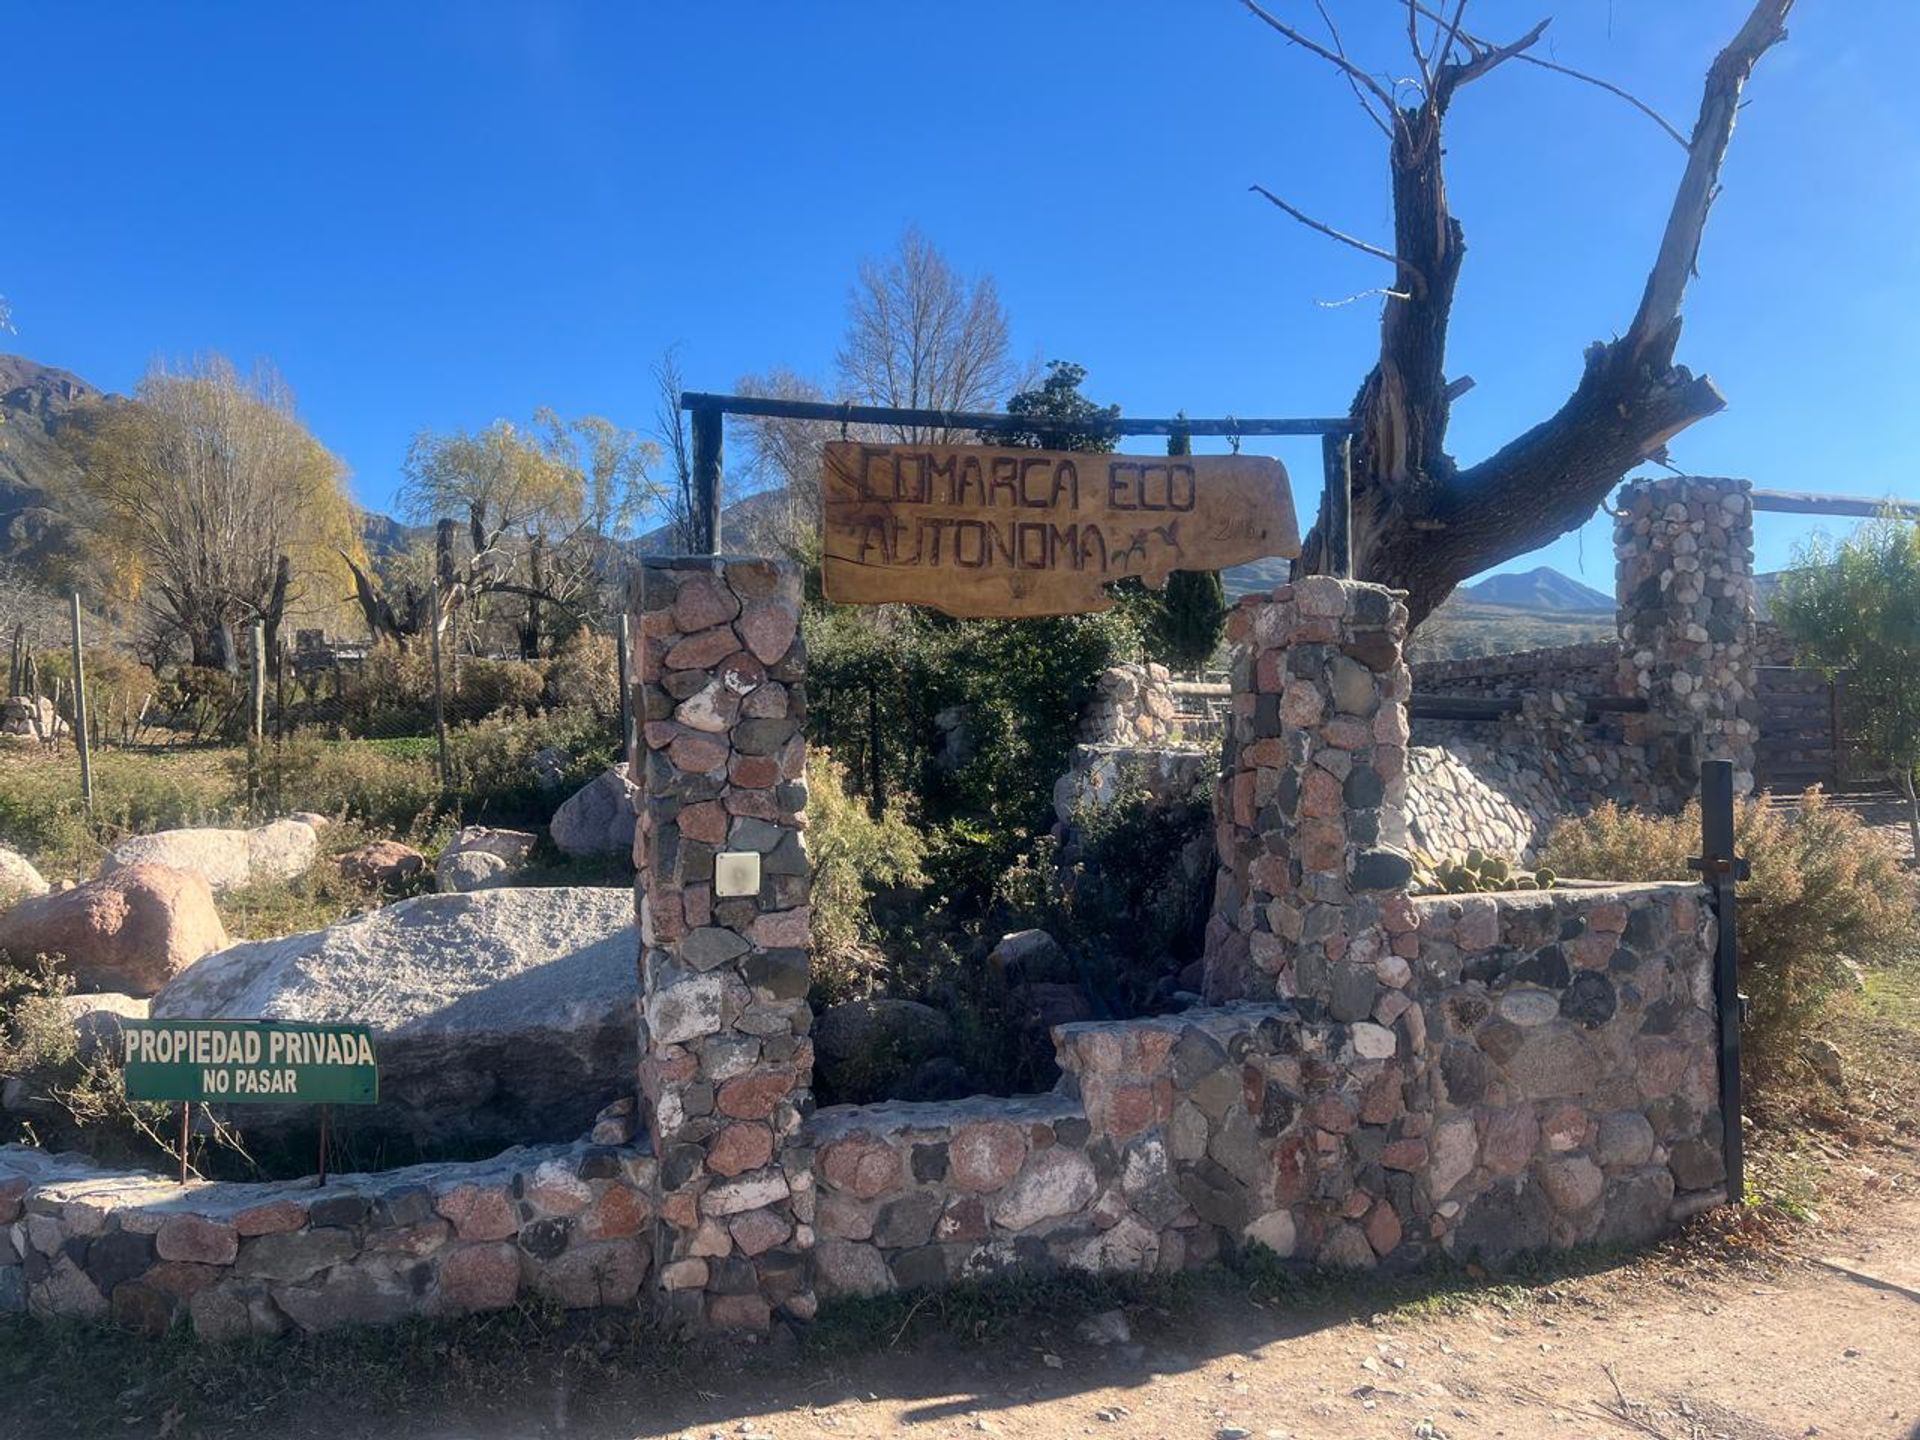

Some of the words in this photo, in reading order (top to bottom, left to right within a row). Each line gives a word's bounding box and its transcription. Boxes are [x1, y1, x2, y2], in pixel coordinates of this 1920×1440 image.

[860, 448, 1079, 510] COMARCA
[1109, 461, 1195, 511] ECO
[857, 515, 1107, 572] AUTONOMA
[125, 1029, 261, 1064] PROPIEDAD
[269, 1031, 375, 1066] PRIVADA
[203, 1069, 230, 1093] NO
[235, 1069, 297, 1094] PASAR
